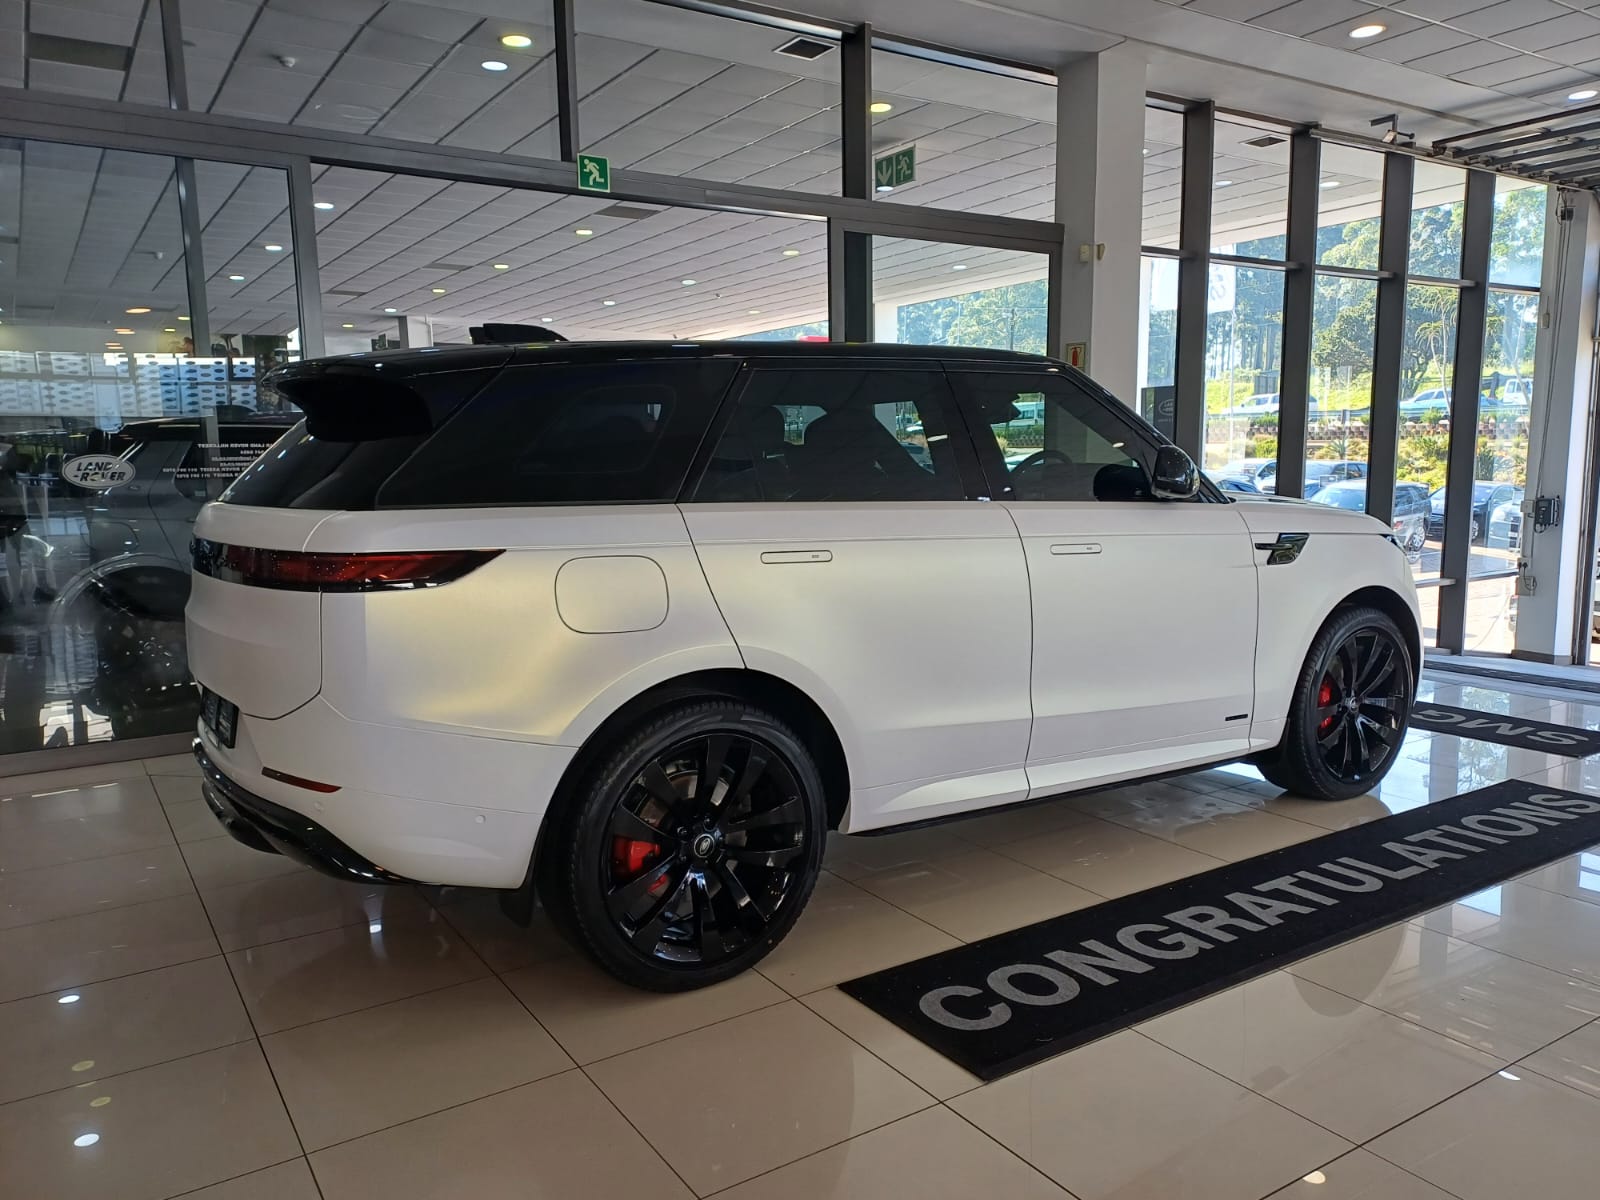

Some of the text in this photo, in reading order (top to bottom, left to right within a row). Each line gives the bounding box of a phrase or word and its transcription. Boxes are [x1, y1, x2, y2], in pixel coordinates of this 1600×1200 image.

[76, 461, 114, 472] LAND
[1411, 709, 1589, 745] SMG
[919, 793, 1600, 1031] CONGRATULATIONS
